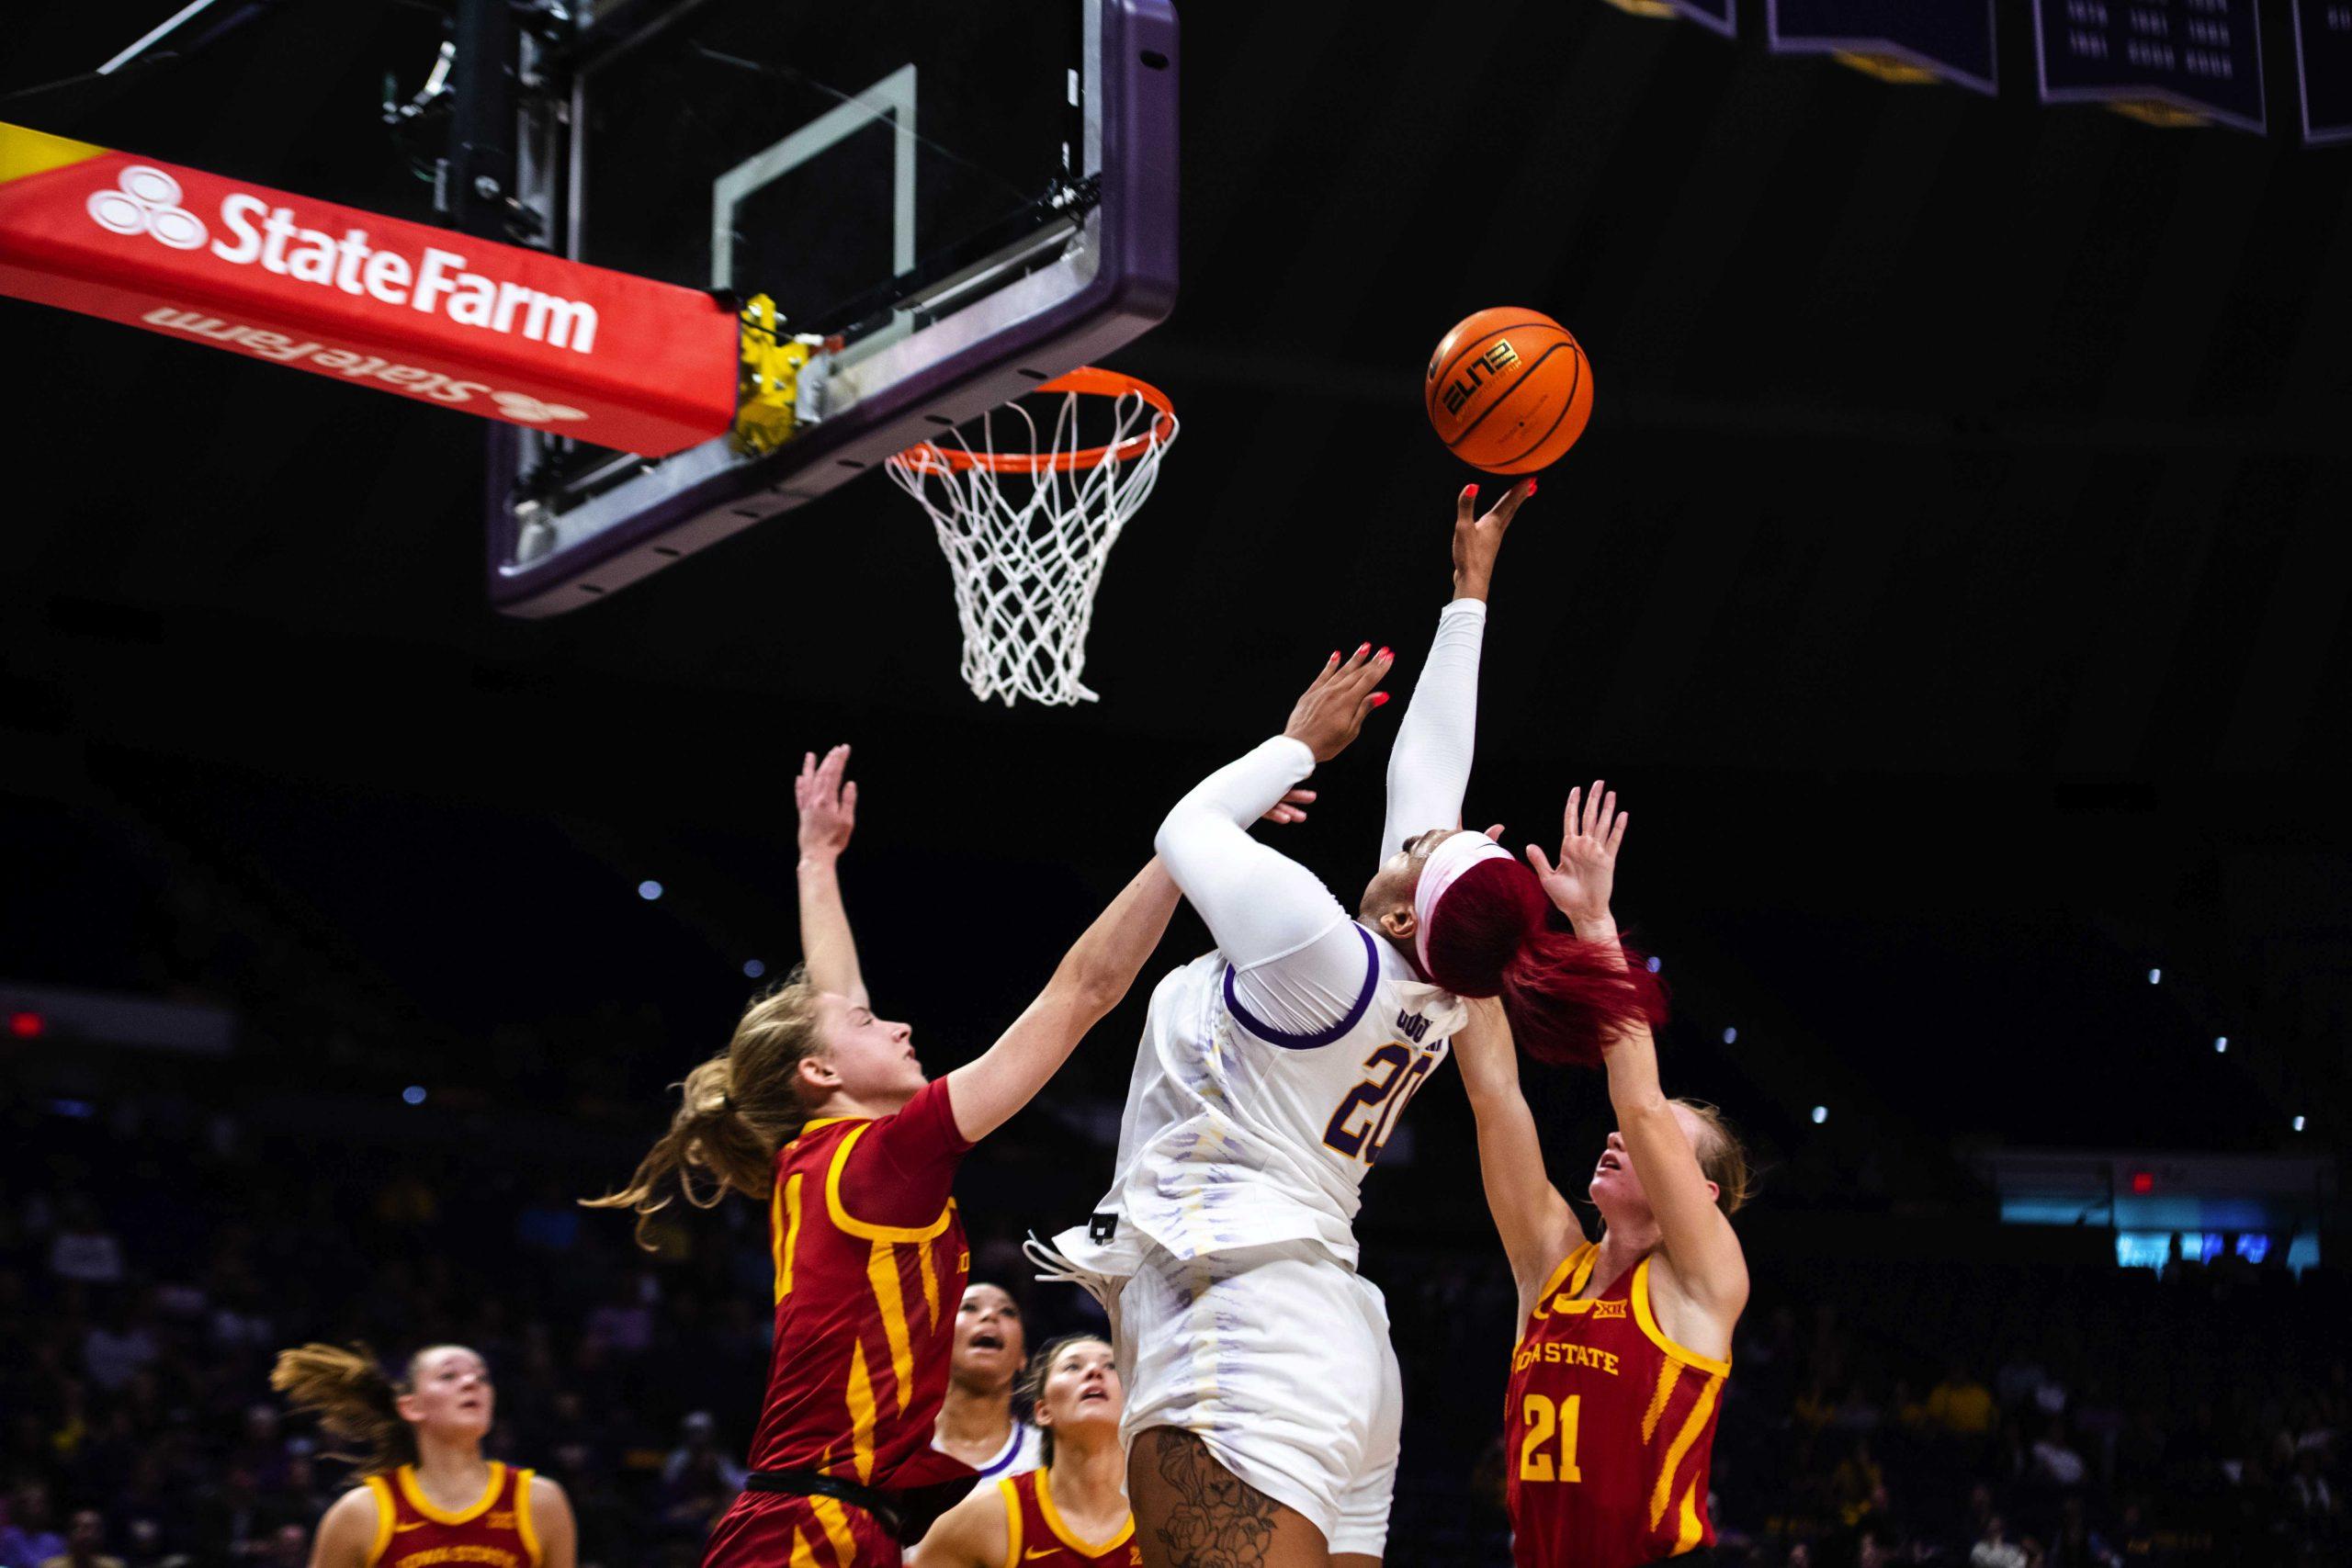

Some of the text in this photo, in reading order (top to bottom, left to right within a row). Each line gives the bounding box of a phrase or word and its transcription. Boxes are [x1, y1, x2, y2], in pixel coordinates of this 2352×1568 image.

[1323, 1042, 1434, 1167] 20
[1544, 1342, 1619, 1376] STATE
[1519, 1393, 1583, 1483] 21
